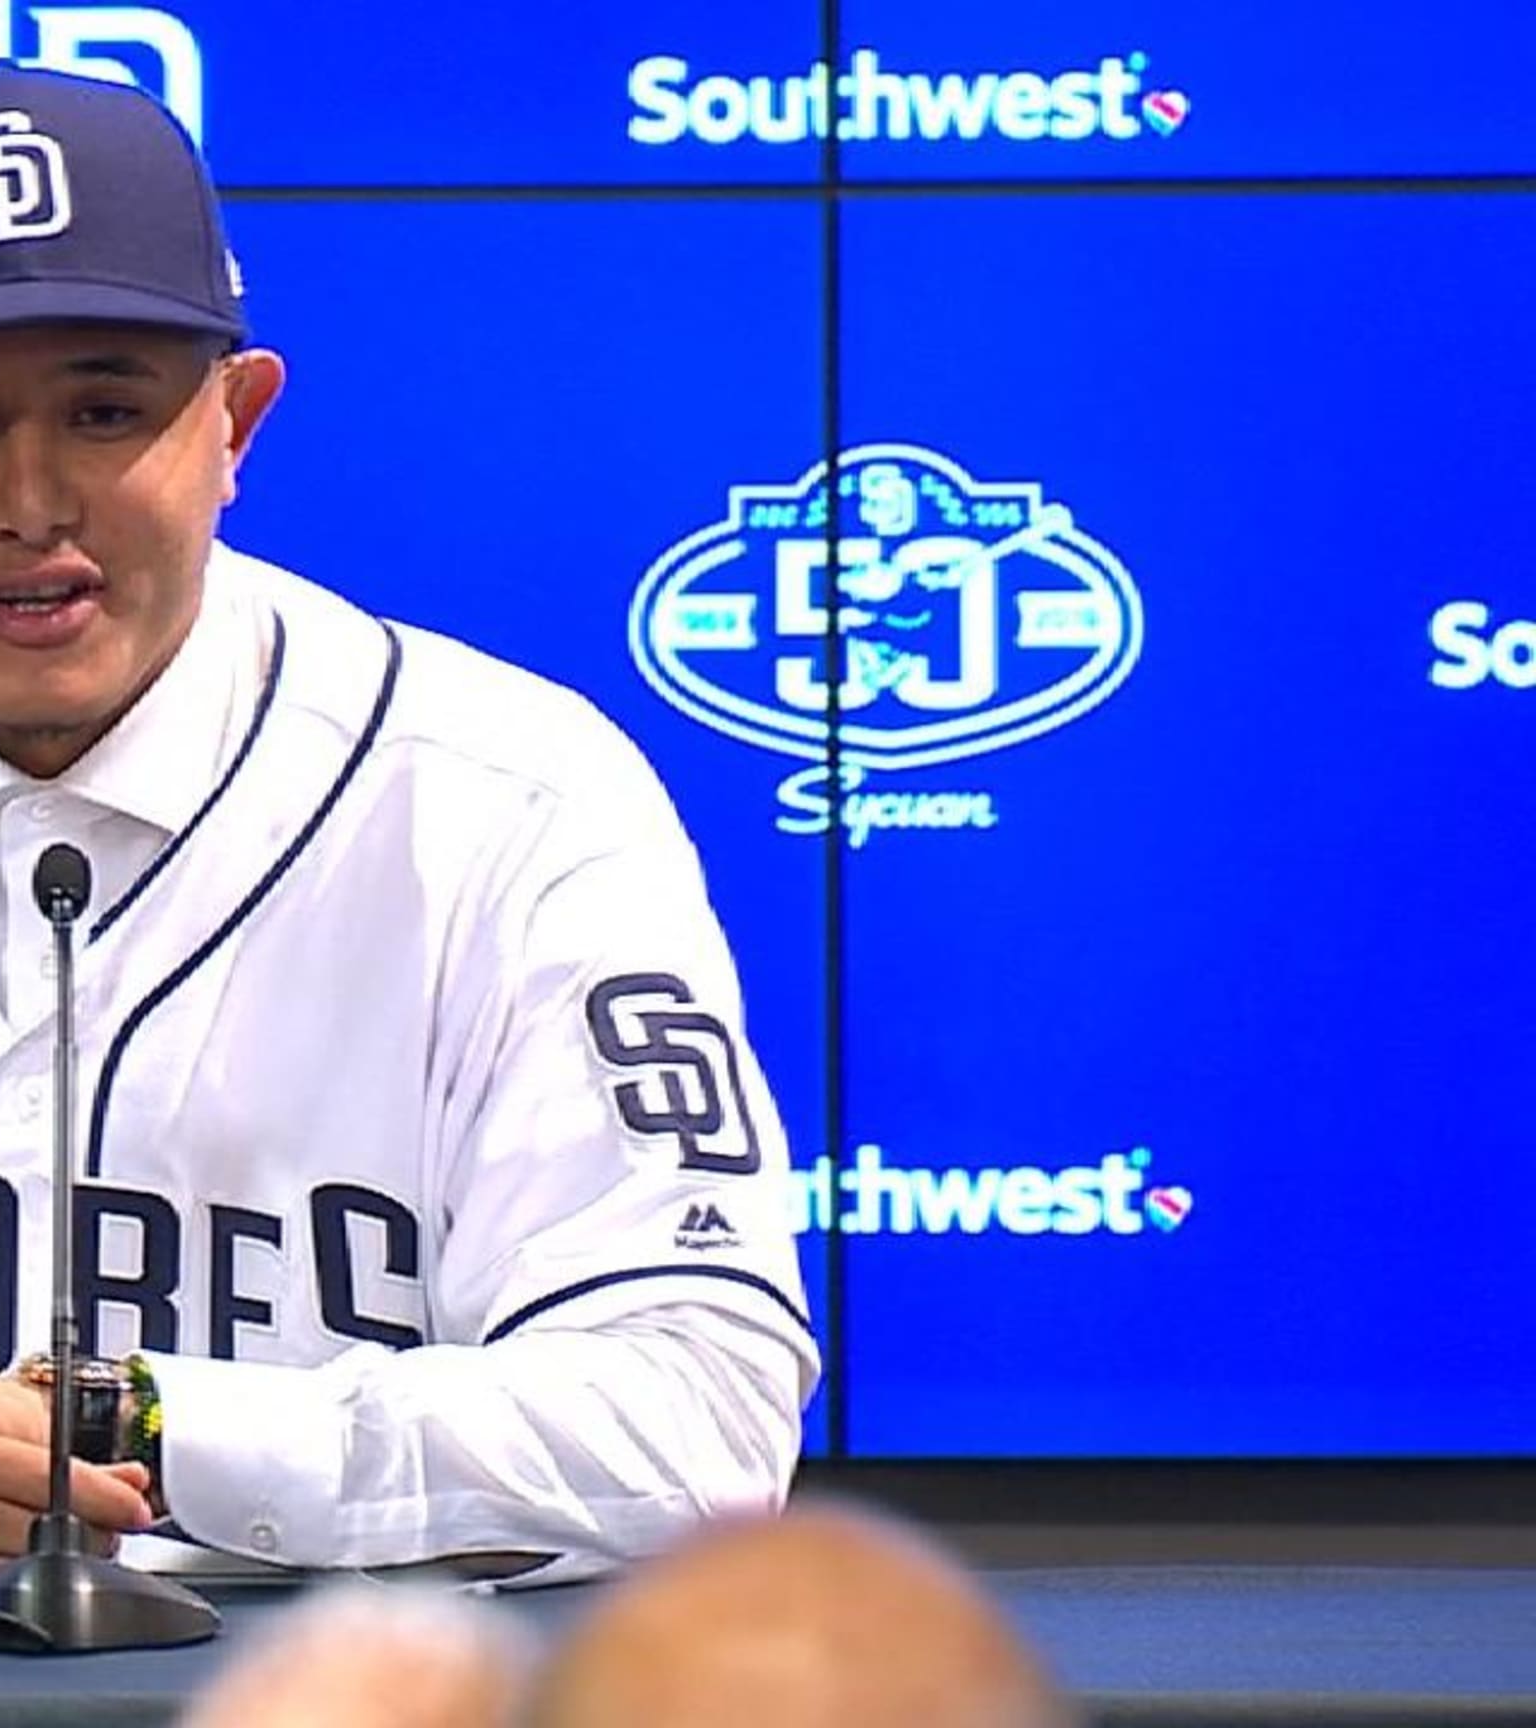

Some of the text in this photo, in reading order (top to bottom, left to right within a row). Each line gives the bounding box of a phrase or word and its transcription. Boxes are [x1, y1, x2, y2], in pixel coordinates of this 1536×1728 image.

[629, 50, 1140, 143] Southwest
[775, 763, 998, 849] Sycuan
[585, 972, 760, 1175] SD
